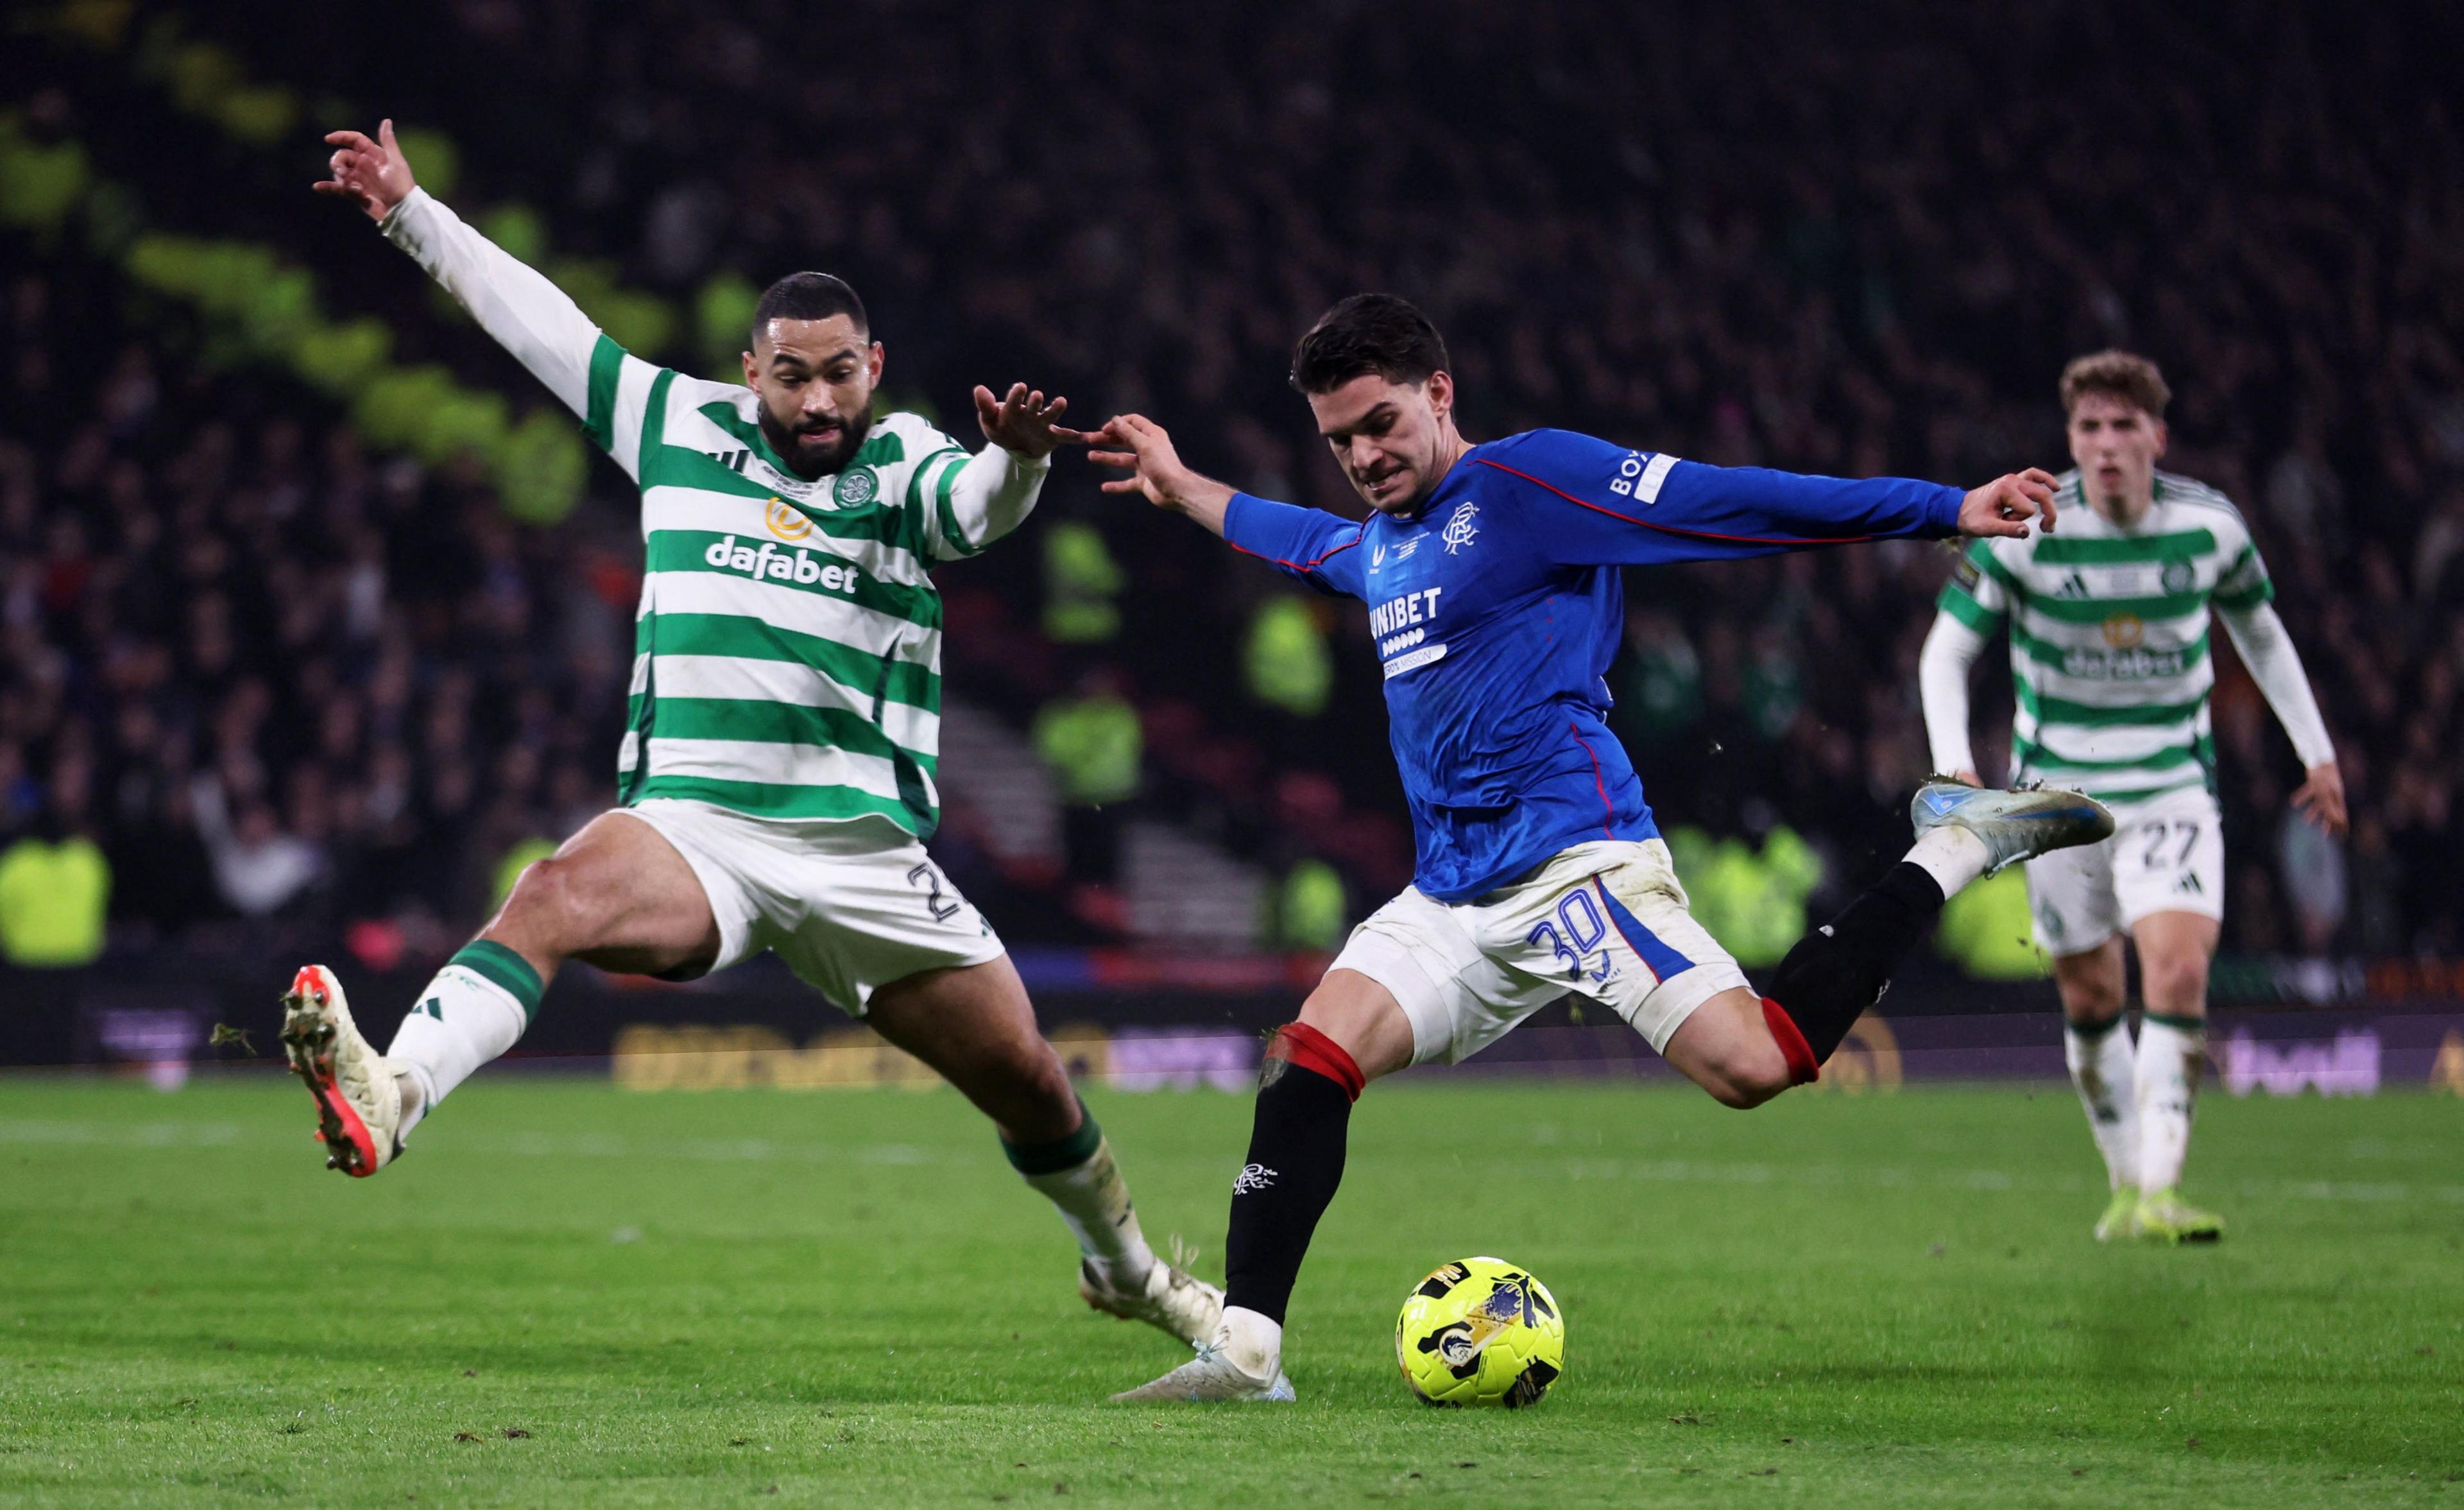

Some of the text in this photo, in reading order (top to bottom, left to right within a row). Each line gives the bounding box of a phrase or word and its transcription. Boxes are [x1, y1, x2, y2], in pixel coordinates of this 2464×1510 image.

[705, 535, 859, 594] dafabet
[1369, 587, 1442, 640] UNIBET
[2143, 820, 2199, 868] 27
[907, 862, 965, 923] 2
[1526, 888, 1605, 982] 30
